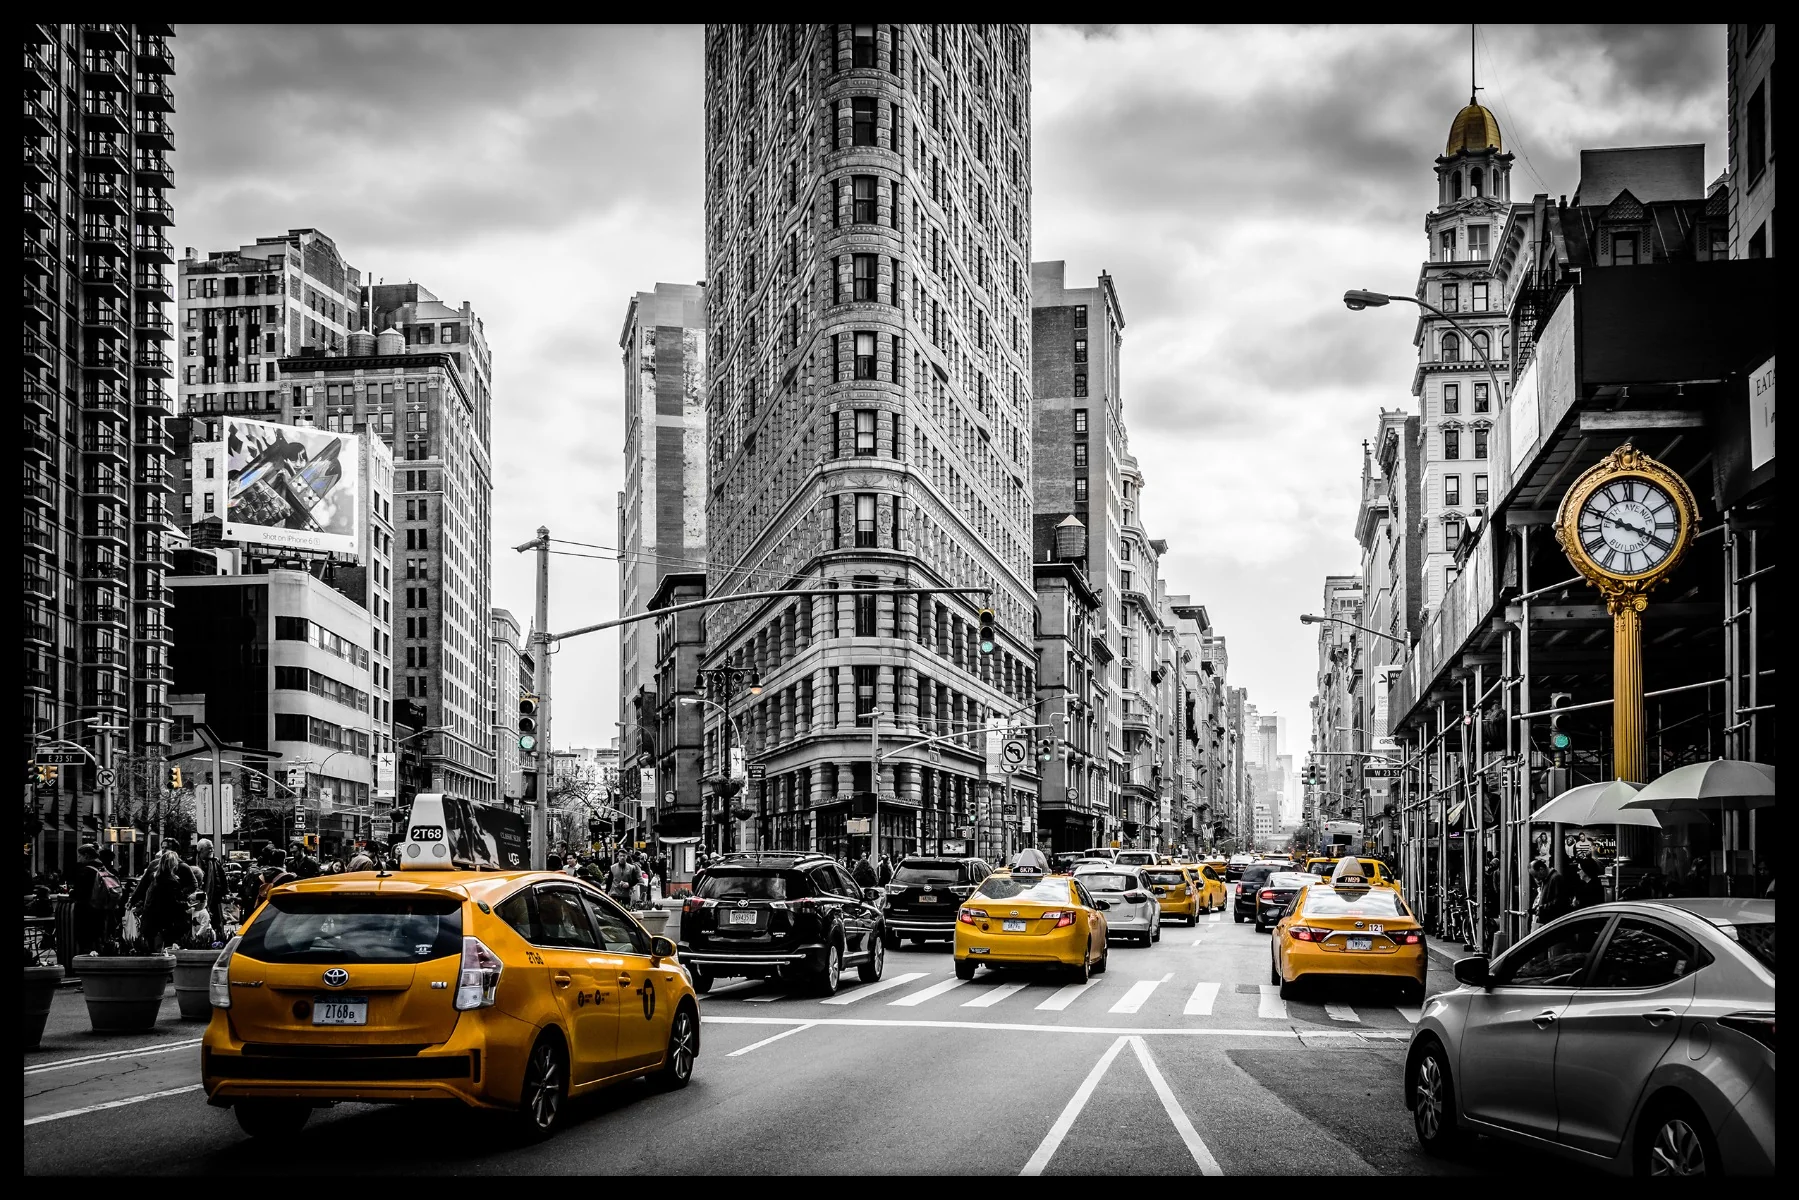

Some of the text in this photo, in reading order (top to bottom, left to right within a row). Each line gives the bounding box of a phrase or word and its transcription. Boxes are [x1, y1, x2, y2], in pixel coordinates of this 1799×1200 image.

[1624, 504, 1653, 526] AVENUE
[263, 532, 277, 541] Shot
[287, 534, 308, 544] iPhone
[1609, 535, 1650, 552] BUILDING
[413, 828, 442, 840] 2T68
[508, 852, 520, 866] UGG
[326, 1004, 355, 1019] 2T68B
